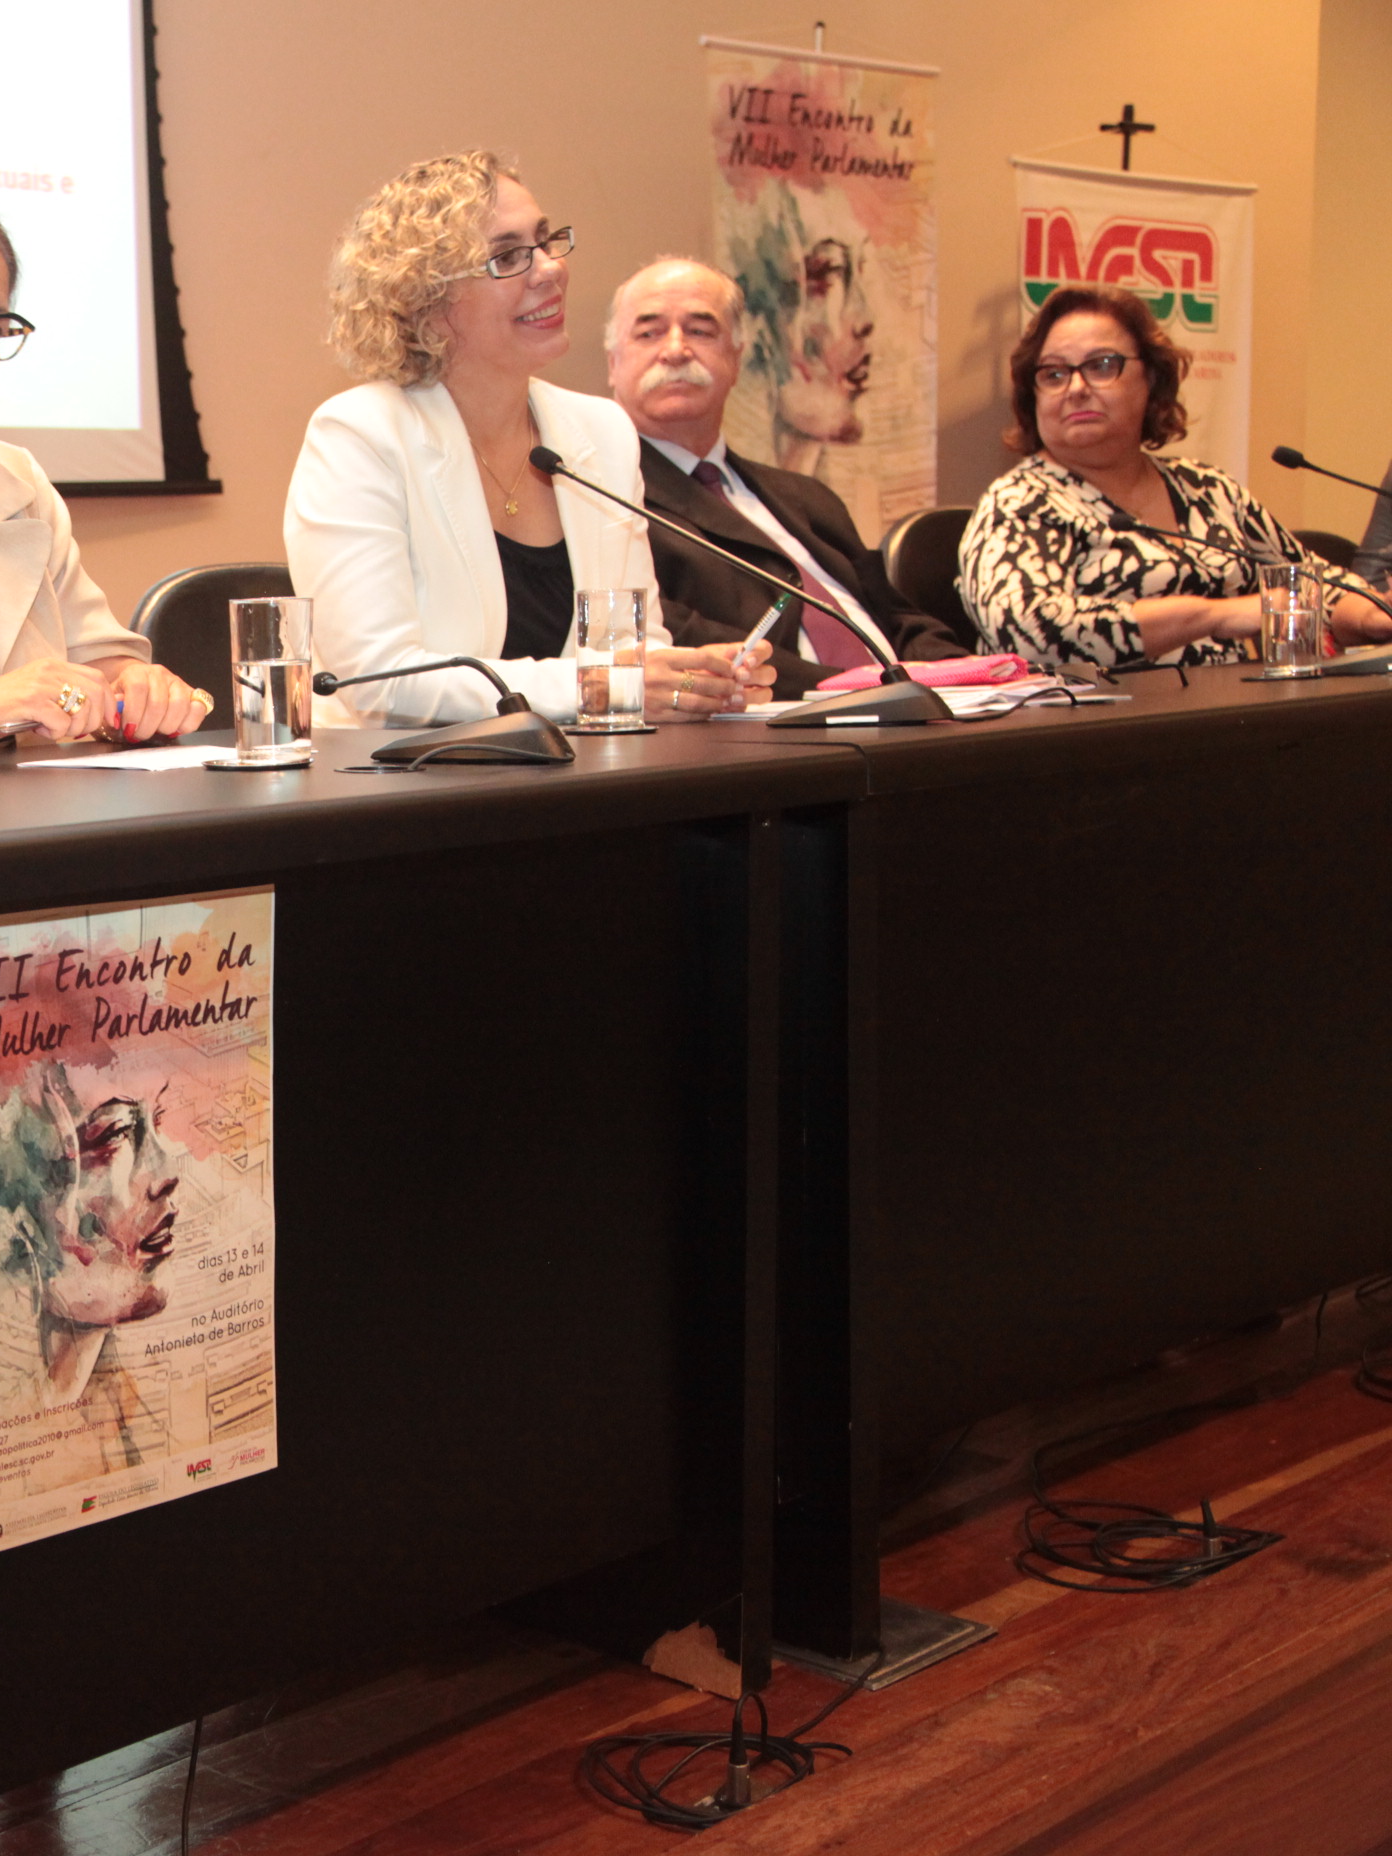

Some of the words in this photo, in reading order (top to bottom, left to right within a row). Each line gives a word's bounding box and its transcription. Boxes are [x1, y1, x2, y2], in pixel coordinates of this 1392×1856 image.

[728, 84, 774, 124] VII
[788, 92, 874, 134] Encontro
[889, 107, 914, 137] da
[728, 131, 797, 170] Mulher
[810, 137, 915, 181] Parlamentar
[60, 176, 75, 194] e
[55, 936, 192, 992] Encontro
[216, 931, 256, 973] da
[91, 981, 258, 1043] Parlamentar
[197, 1254, 223, 1270] dias
[226, 1248, 238, 1264] 13
[241, 1248, 249, 1259] e
[252, 1242, 264, 1256] 14
[218, 1270, 234, 1284] de
[238, 1260, 265, 1280] Abril
[191, 1314, 207, 1328] no
[210, 1299, 265, 1323] Auditório
[144, 1331, 205, 1358] Antonieta
[208, 1326, 224, 1341] de
[227, 1315, 265, 1336] Barros
[34, 1411, 41, 1421] e
[43, 1397, 94, 1419] Inscrições
